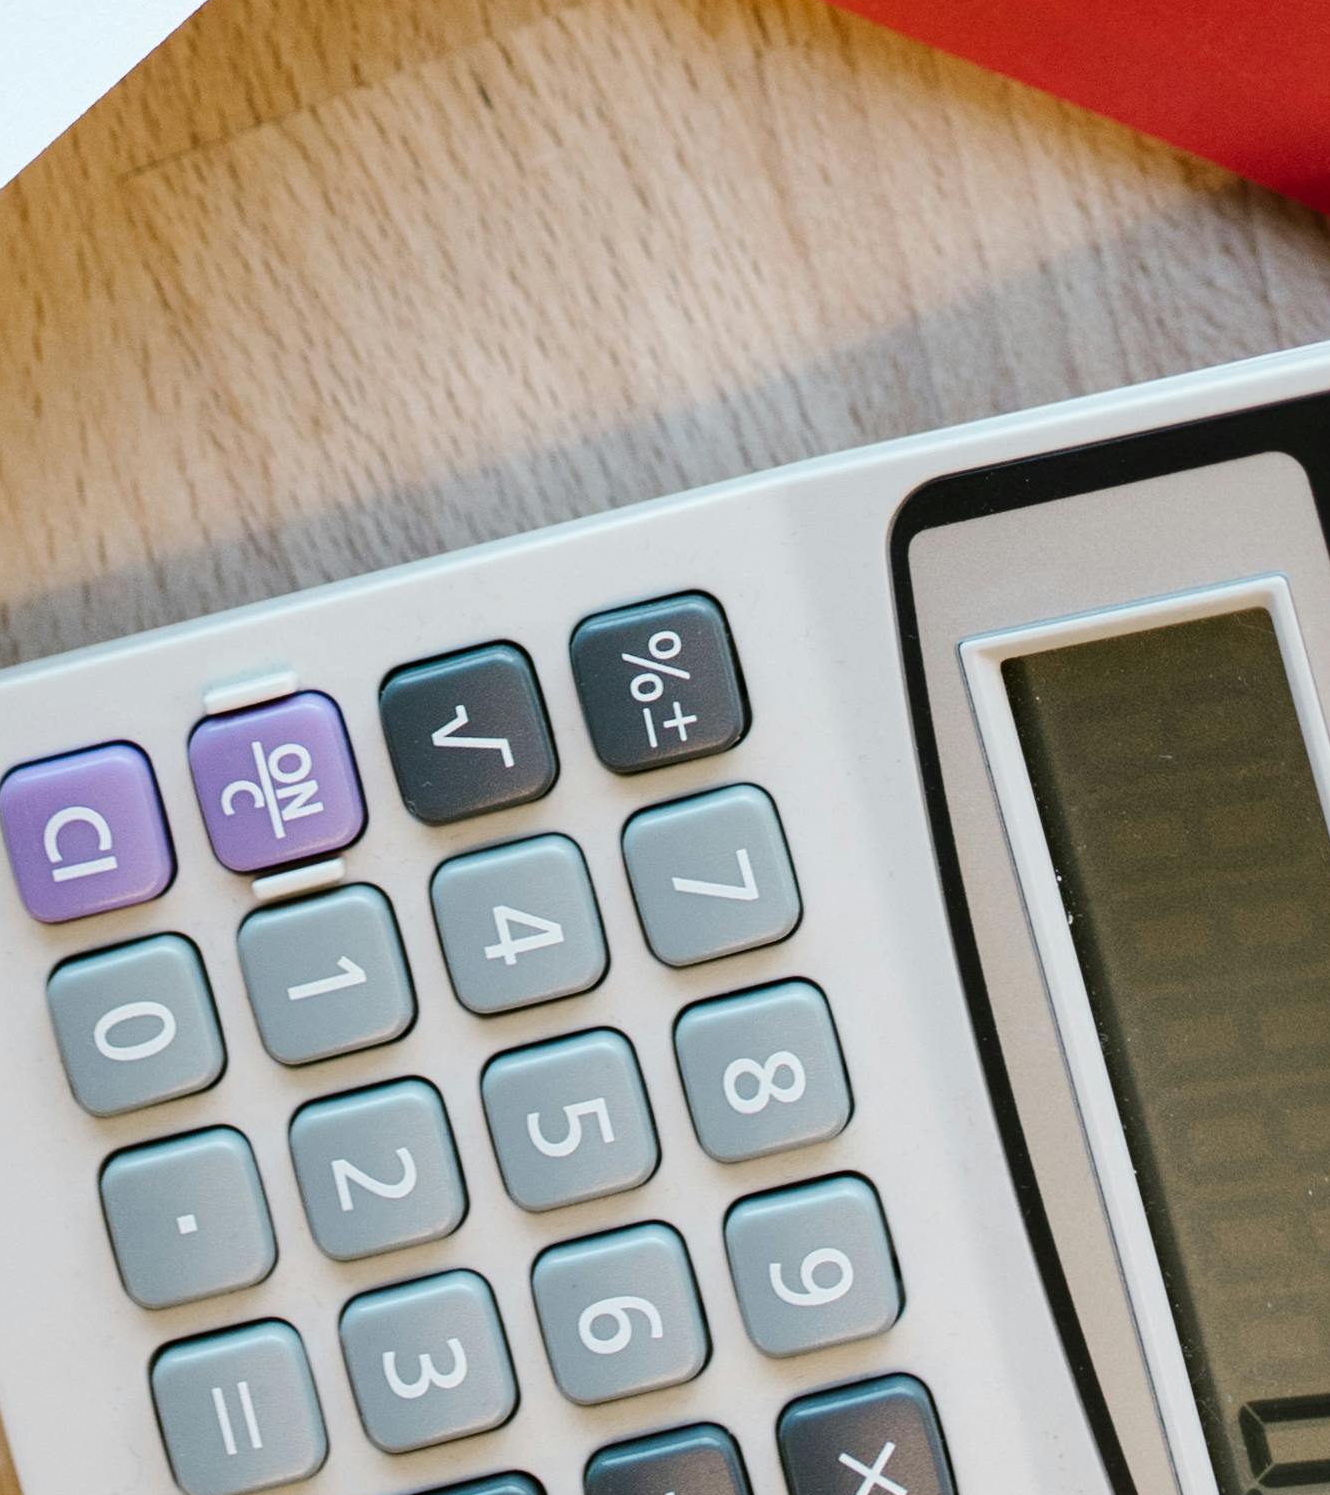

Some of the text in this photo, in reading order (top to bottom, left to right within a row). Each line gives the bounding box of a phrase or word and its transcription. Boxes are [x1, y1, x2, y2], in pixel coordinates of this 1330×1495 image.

[220, 780, 266, 818] C
[268, 742, 324, 823] ON
[673, 849, 759, 900] 7
[485, 906, 564, 964] 4
[288, 957, 366, 999] 1
[95, 1002, 175, 1060] 0
[725, 1051, 805, 1113] 8
[528, 1098, 615, 1156] 5
[332, 1148, 416, 1210] 2
[771, 1249, 853, 1305] 9
[580, 1297, 663, 1353] 6
[382, 1337, 468, 1400] 3
